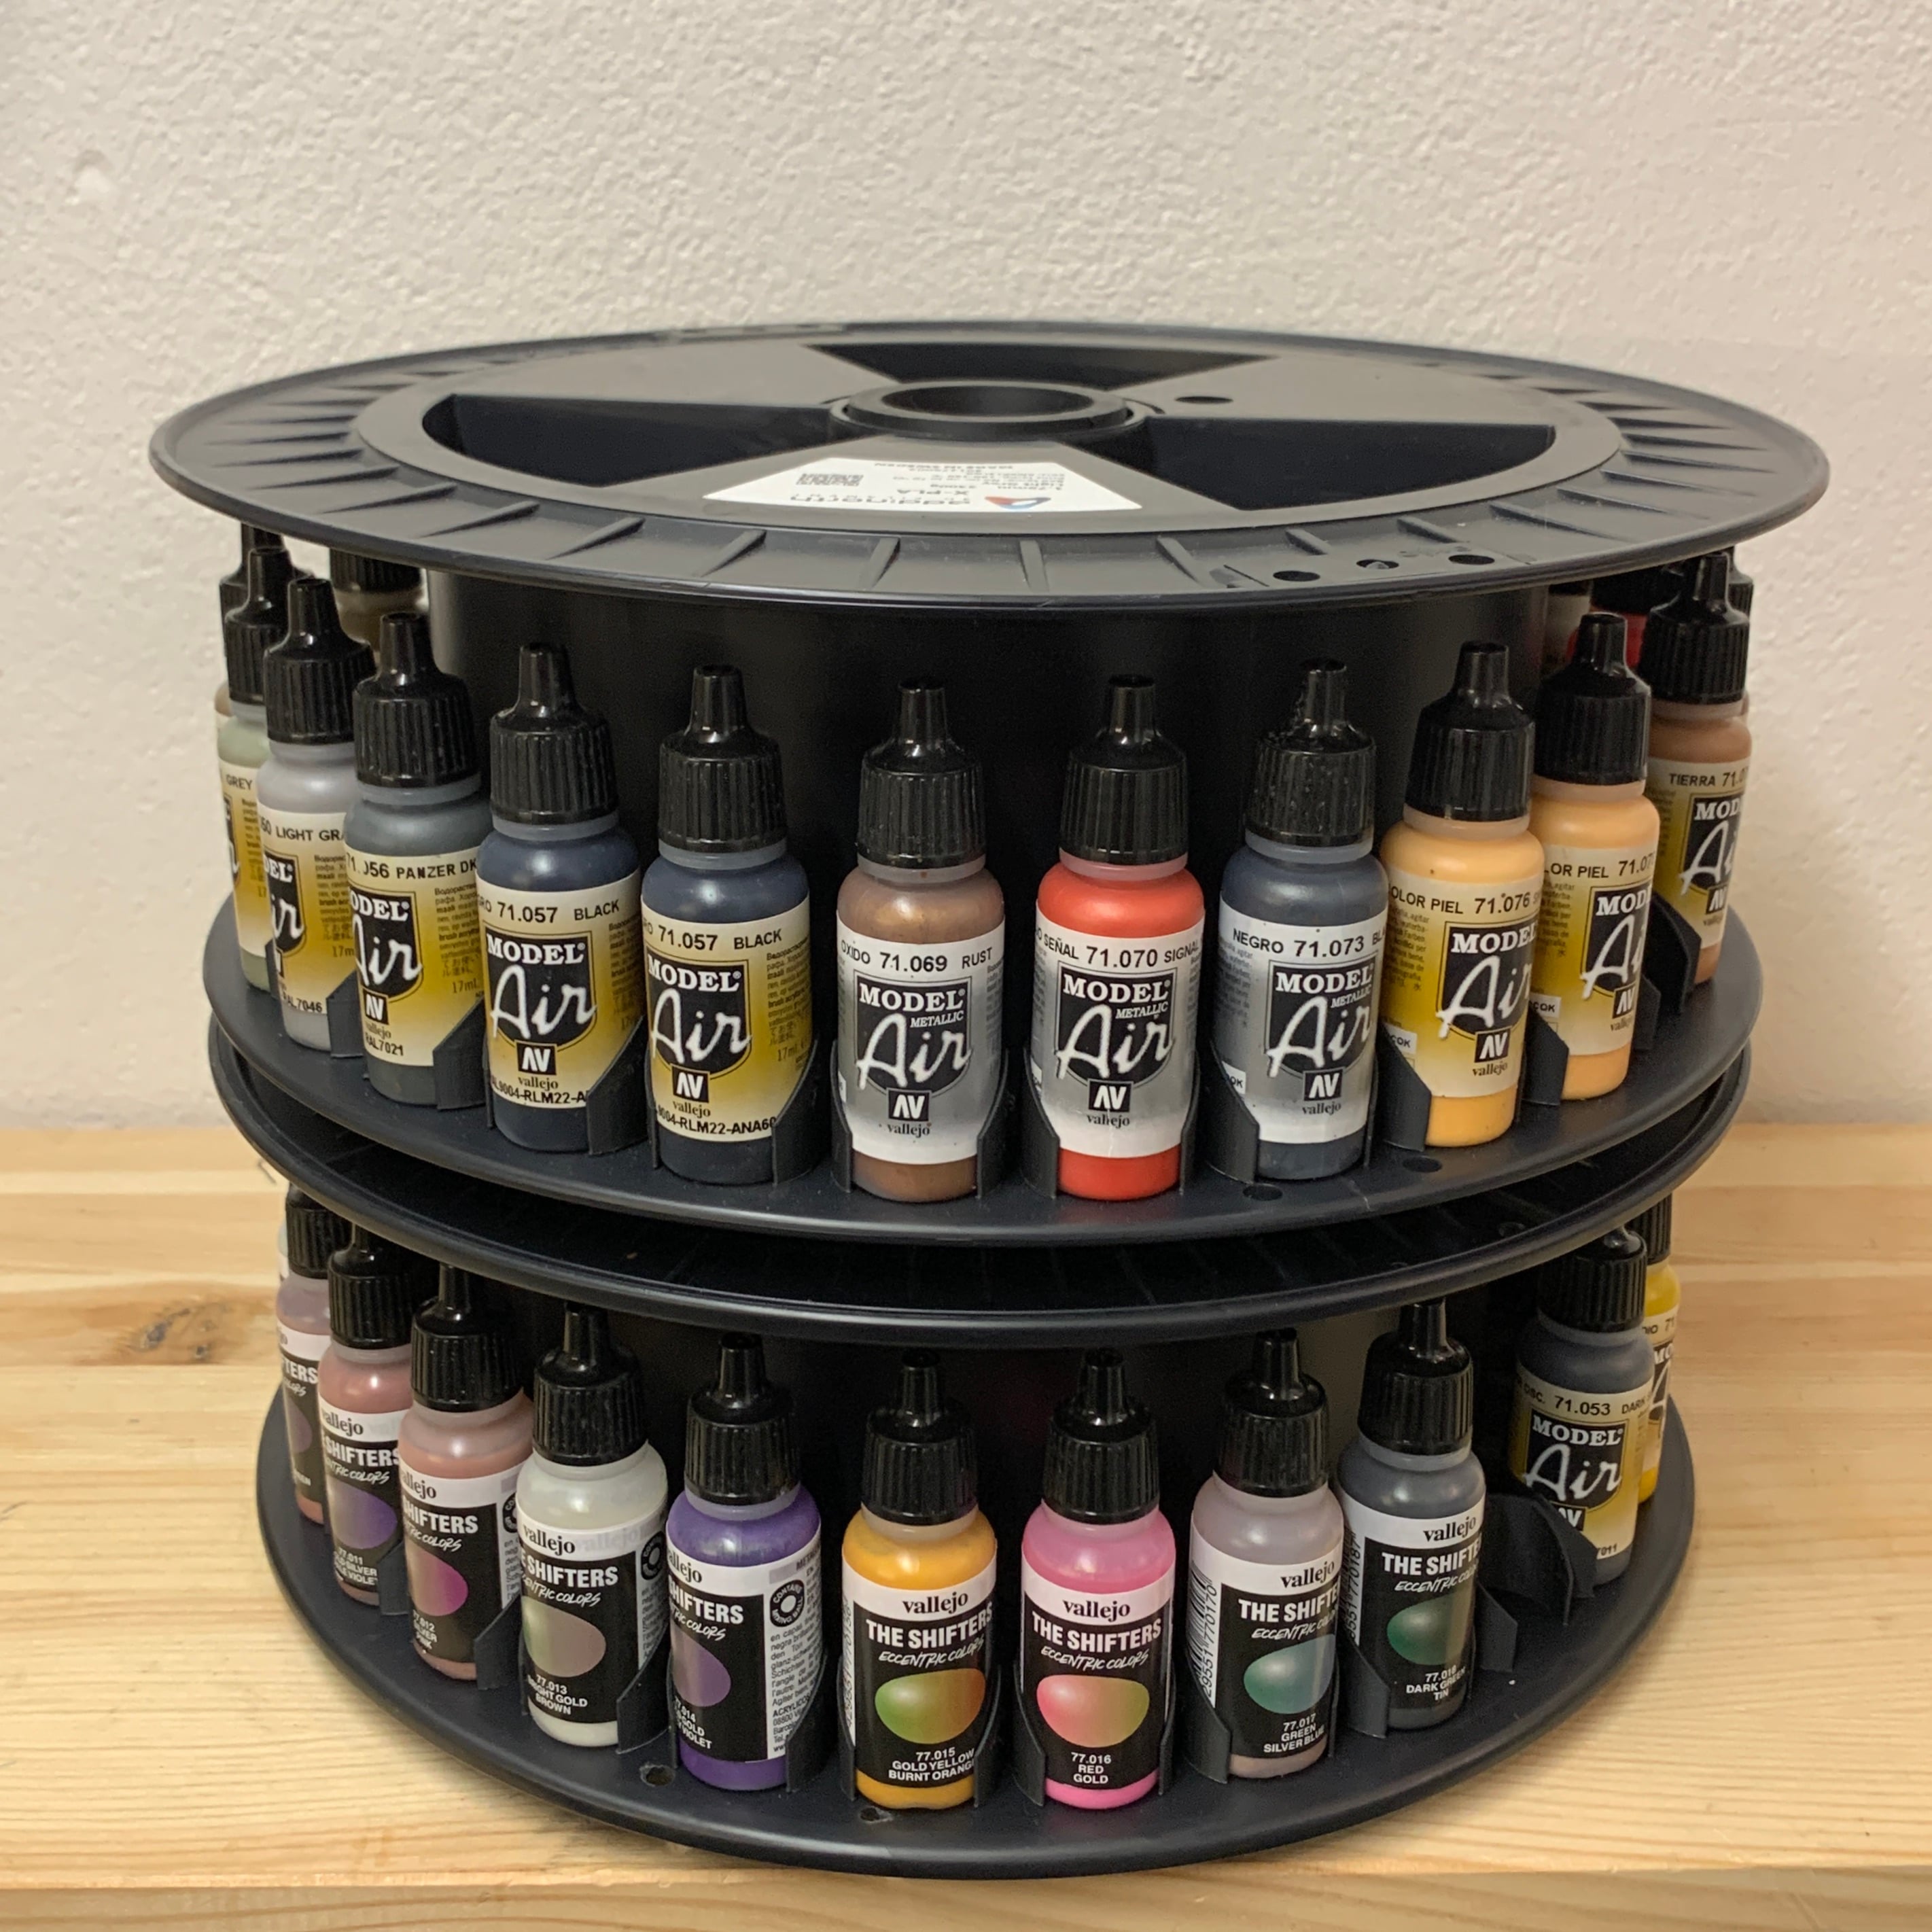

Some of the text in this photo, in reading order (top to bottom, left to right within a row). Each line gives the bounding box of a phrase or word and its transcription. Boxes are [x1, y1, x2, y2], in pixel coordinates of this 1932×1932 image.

[226, 775, 252, 790] GREY
[1669, 773, 1716, 787] TIERRA
[1694, 797, 1741, 821] MOD
[276, 825, 313, 841] LIGHT
[319, 828, 344, 841] GR
[396, 864, 456, 879] PANZER
[1577, 866, 1609, 878] PIEL
[350, 890, 408, 921] ODEL
[497, 901, 559, 924] 71.057
[574, 899, 620, 921] BLACK
[1391, 885, 1425, 909] OLOR
[1430, 898, 1463, 915] PIEL
[1475, 892, 1530, 914] 71.076
[1595, 885, 1651, 916] MOD
[486, 932, 584, 965] MODEL
[658, 924, 718, 951] 71.057
[734, 928, 783, 951] BLACK
[1233, 928, 1284, 953] NEGRO
[1294, 935, 1365, 958] 71.073
[880, 951, 948, 972] 71.069
[962, 947, 992, 970] RUST
[1044, 934, 1079, 960] SEÑAL
[1086, 946, 1158, 968] 71.070
[648, 953, 739, 992] MODEL
[1275, 964, 1373, 994] MODEL
[859, 983, 964, 1013] MODEL
[1063, 973, 1170, 1004] MODEL
[1331, 983, 1371, 1008] METALLIC
[490, 964, 597, 1039] Air
[1115, 1001, 1169, 1019] METALLIC
[650, 987, 753, 1064] Air
[910, 1011, 964, 1028] METALLIC
[1055, 1004, 1176, 1080] Air
[1266, 995, 1370, 1078] Air
[1479, 1032, 1507, 1059] AV
[521, 1047, 551, 1072] AV
[856, 1013, 972, 1090] Air
[1472, 1062, 1508, 1077] vallejo
[518, 1076, 559, 1092] vallejo
[676, 1072, 703, 1099] AV
[1308, 1072, 1340, 1099] AV
[672, 1100, 711, 1119] vallejo
[892, 1094, 926, 1119] AV
[1093, 1085, 1127, 1110] AV
[1302, 1102, 1341, 1116] vallejo
[886, 1123, 930, 1138] vallejo
[1087, 1113, 1130, 1129] vallejo
[1555, 1395, 1611, 1416] 71.053
[323, 1411, 364, 1437] allejo
[1532, 1415, 1621, 1447] MODEL
[326, 1435, 399, 1466] SHIFTERS
[349, 1471, 390, 1485] COLORS
[1524, 1443, 1622, 1502] Air
[523, 1524, 576, 1556] vallejo
[1423, 1516, 1476, 1542] vallejo
[422, 1534, 462, 1552] COLORS
[1382, 1534, 1480, 1576] THE SHIFTE
[527, 1555, 618, 1588] SHIFTERS
[668, 1550, 702, 1583] allejo
[1280, 1561, 1335, 1588] vallejo
[1394, 1576, 1457, 1594] ECCENTRIC
[556, 1592, 601, 1607] COLORS
[902, 1592, 968, 1615] vallejo
[1063, 1600, 1131, 1622] vallejo
[1237, 1579, 1339, 1623] THE SHIFTE
[686, 1619, 726, 1640] COLORS
[866, 1602, 993, 1649] THE SHIFTERS
[1032, 1611, 1161, 1653] THE SHIFTERS
[1251, 1623, 1316, 1640] ECCENTRIC
[879, 1634, 984, 1668] ECCENTRIC COLORS
[1041, 1646, 1150, 1671] ECCENTRIC COLORS
[536, 1674, 567, 1695] 77.013
[1425, 1665, 1456, 1683] 77.018
[1406, 1682, 1439, 1693] DARK
[1434, 1688, 1449, 1700] TIN
[535, 1693, 571, 1715] BROWN
[555, 1694, 588, 1707] GOLD
[682, 1716, 705, 1736] GOLD
[1281, 1723, 1316, 1742] GREEN
[1283, 1713, 1316, 1732] 77.017
[682, 1725, 712, 1749] VIOLET
[1263, 1724, 1324, 1753] SILVER BLUE
[892, 1748, 974, 1772] GOLD YELLOW
[916, 1747, 955, 1761] 77.015
[1071, 1752, 1112, 1764] 77.016
[889, 1770, 930, 1781] BURNT
[1073, 1773, 1108, 1785] GOLD
[1078, 1764, 1104, 1774] RED
